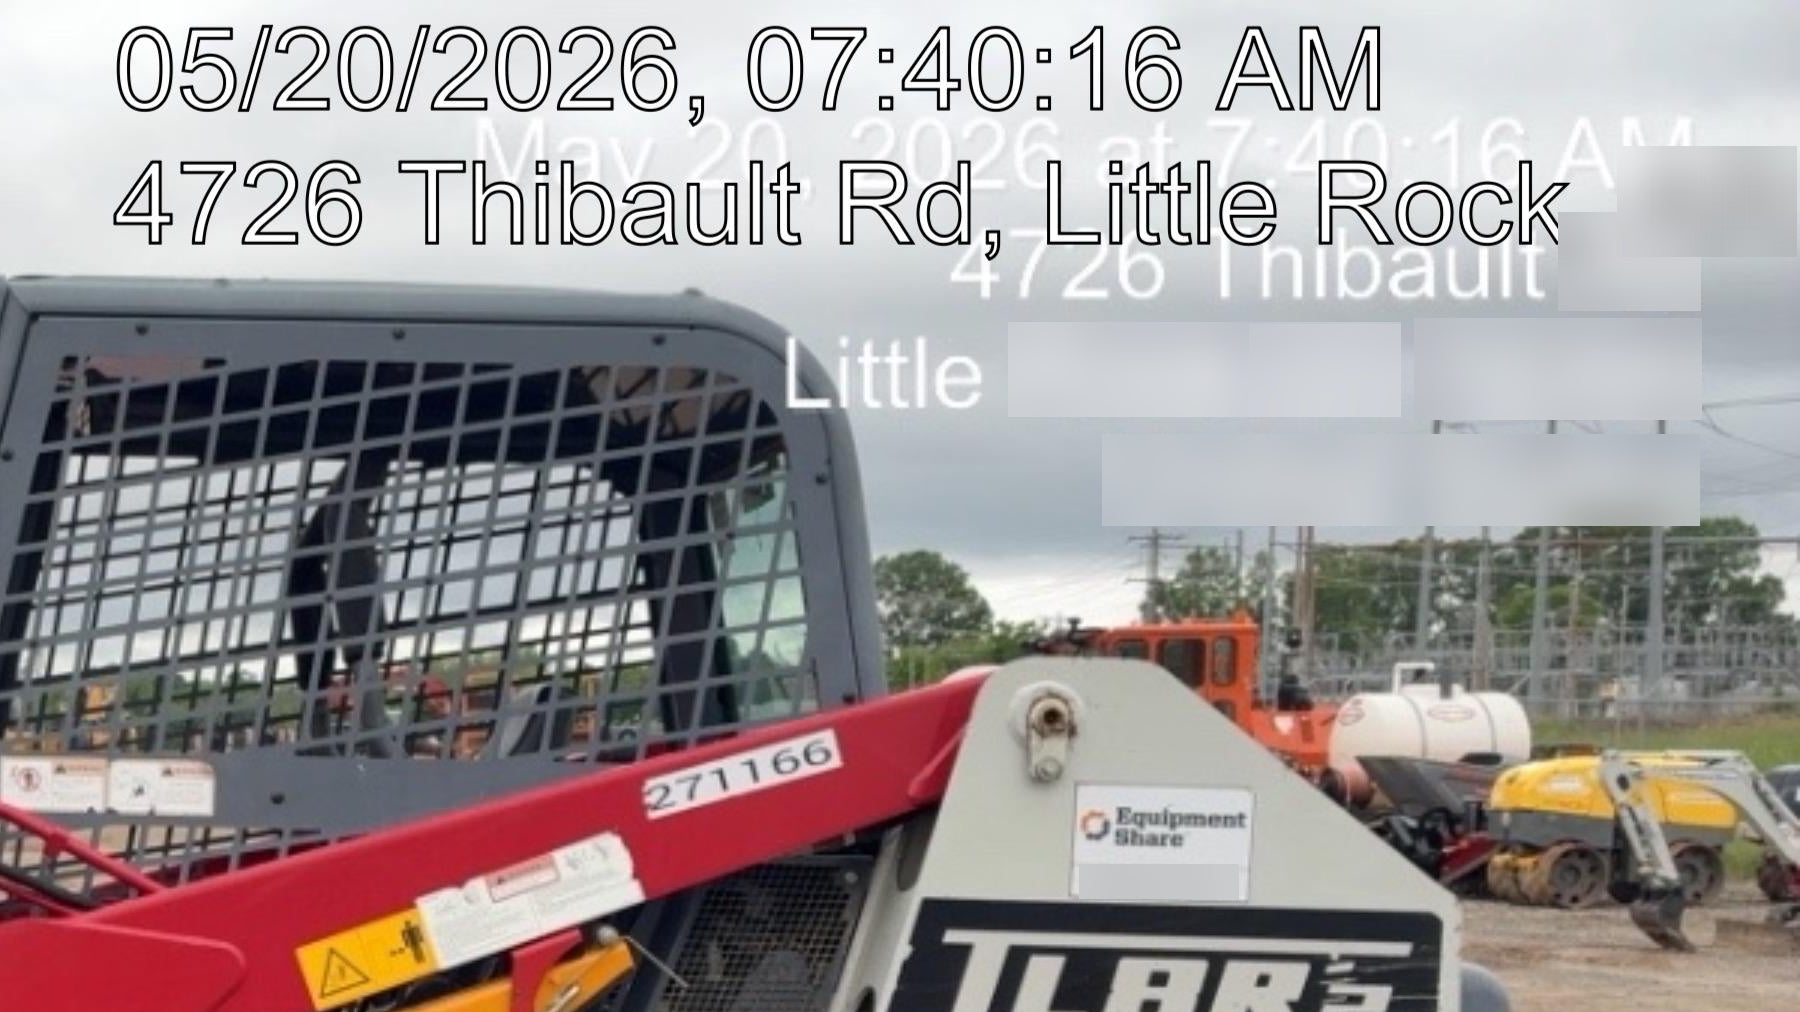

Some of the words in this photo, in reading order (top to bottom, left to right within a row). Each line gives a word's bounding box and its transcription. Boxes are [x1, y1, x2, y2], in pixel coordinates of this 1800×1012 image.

[645, 738, 833, 811] 271166
[1115, 806, 1247, 830] Equipment
[1115, 828, 1184, 847] Share
